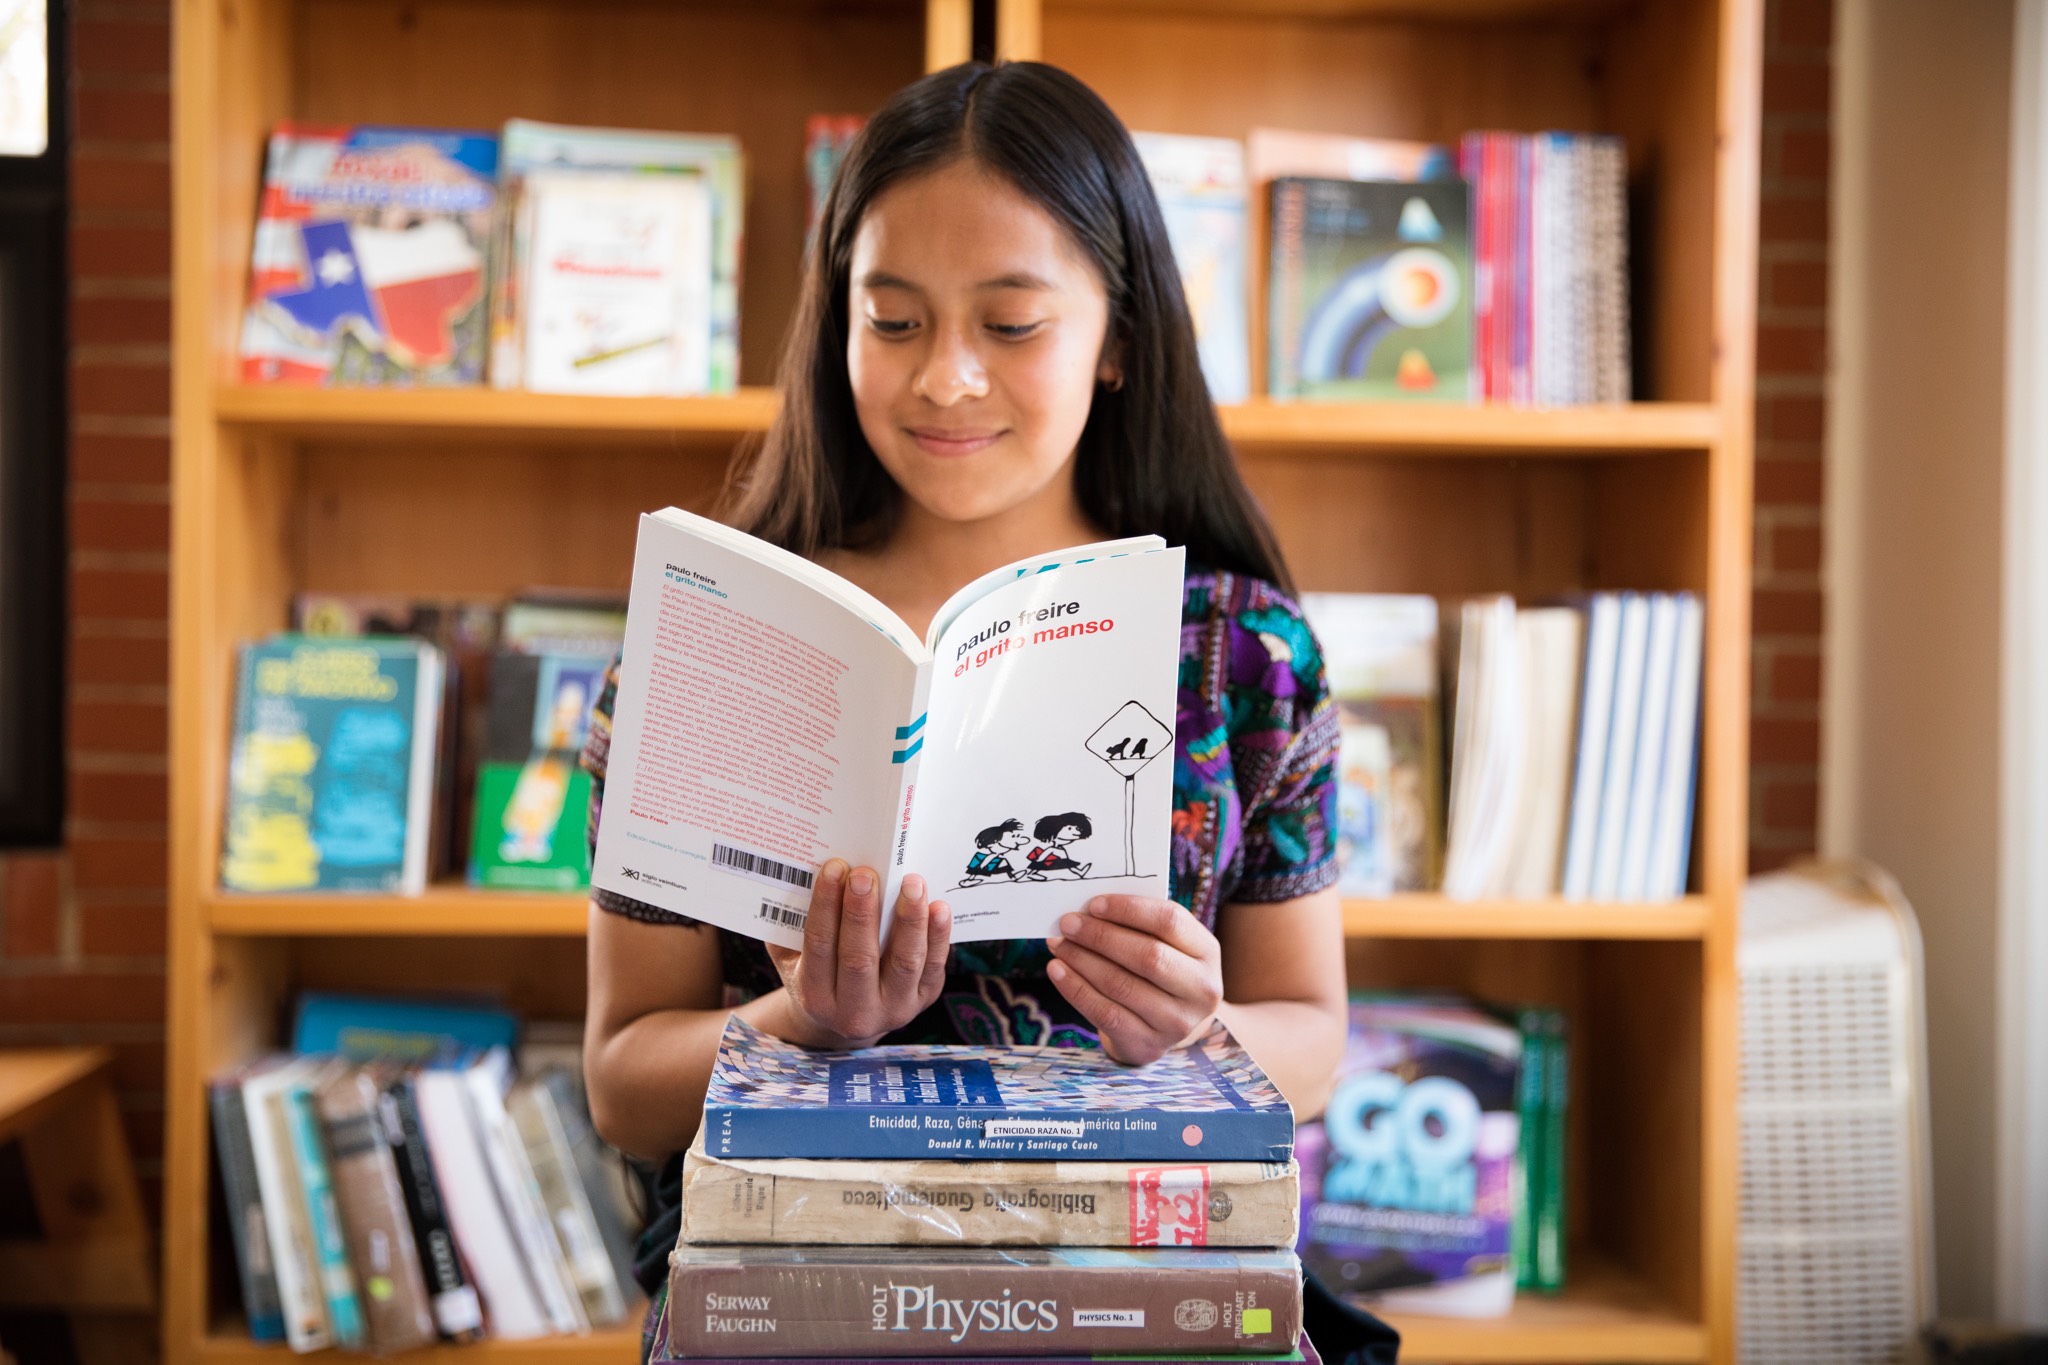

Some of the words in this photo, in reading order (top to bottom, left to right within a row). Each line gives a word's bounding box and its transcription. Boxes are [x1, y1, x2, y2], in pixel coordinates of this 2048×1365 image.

[664, 570, 673, 578] el
[675, 573, 696, 587] grito
[698, 583, 727, 599] manso
[666, 562, 691, 576] paulo
[692, 571, 716, 586] freire
[956, 620, 1011, 661] paulo
[1018, 601, 1080, 627] freire
[954, 656, 970, 678] el
[975, 636, 1025, 668] grito
[1033, 619, 1114, 644] manso
[630, 808, 648, 819] Paulo
[649, 815, 668, 825] Freire
[898, 831, 907, 848] freire
[642, 872, 657, 881] siglo
[658, 877, 687, 890] veintiuno
[869, 1115, 921, 1131] Etnicidad,
[925, 1115, 953, 1131] Raza,
[957, 1113, 986, 1130] Géne
[1080, 1116, 1122, 1131] América
[1124, 1117, 1157, 1131] Latina
[1326, 1070, 1482, 1163] GO
[722, 1111, 732, 1153] PREAL
[993, 1127, 1036, 1135] ETNICIDAD
[1038, 1127, 1059, 1135] RAZA
[1060, 1127, 1074, 1135] No.
[928, 1139, 961, 1149] Donald
[965, 1139, 976, 1149] R.
[978, 1139, 1015, 1150] Winkler
[1018, 1142, 1024, 1151] y
[1027, 1140, 1068, 1151] Santiago
[1072, 1140, 1099, 1150] Cueto
[872, 1284, 888, 1331] HOLT
[891, 1284, 1058, 1343] Physics
[1079, 1314, 1111, 1322] PHYSICS
[1223, 1302, 1233, 1328] HOLT
[1234, 1290, 1245, 1339] RINEHART
